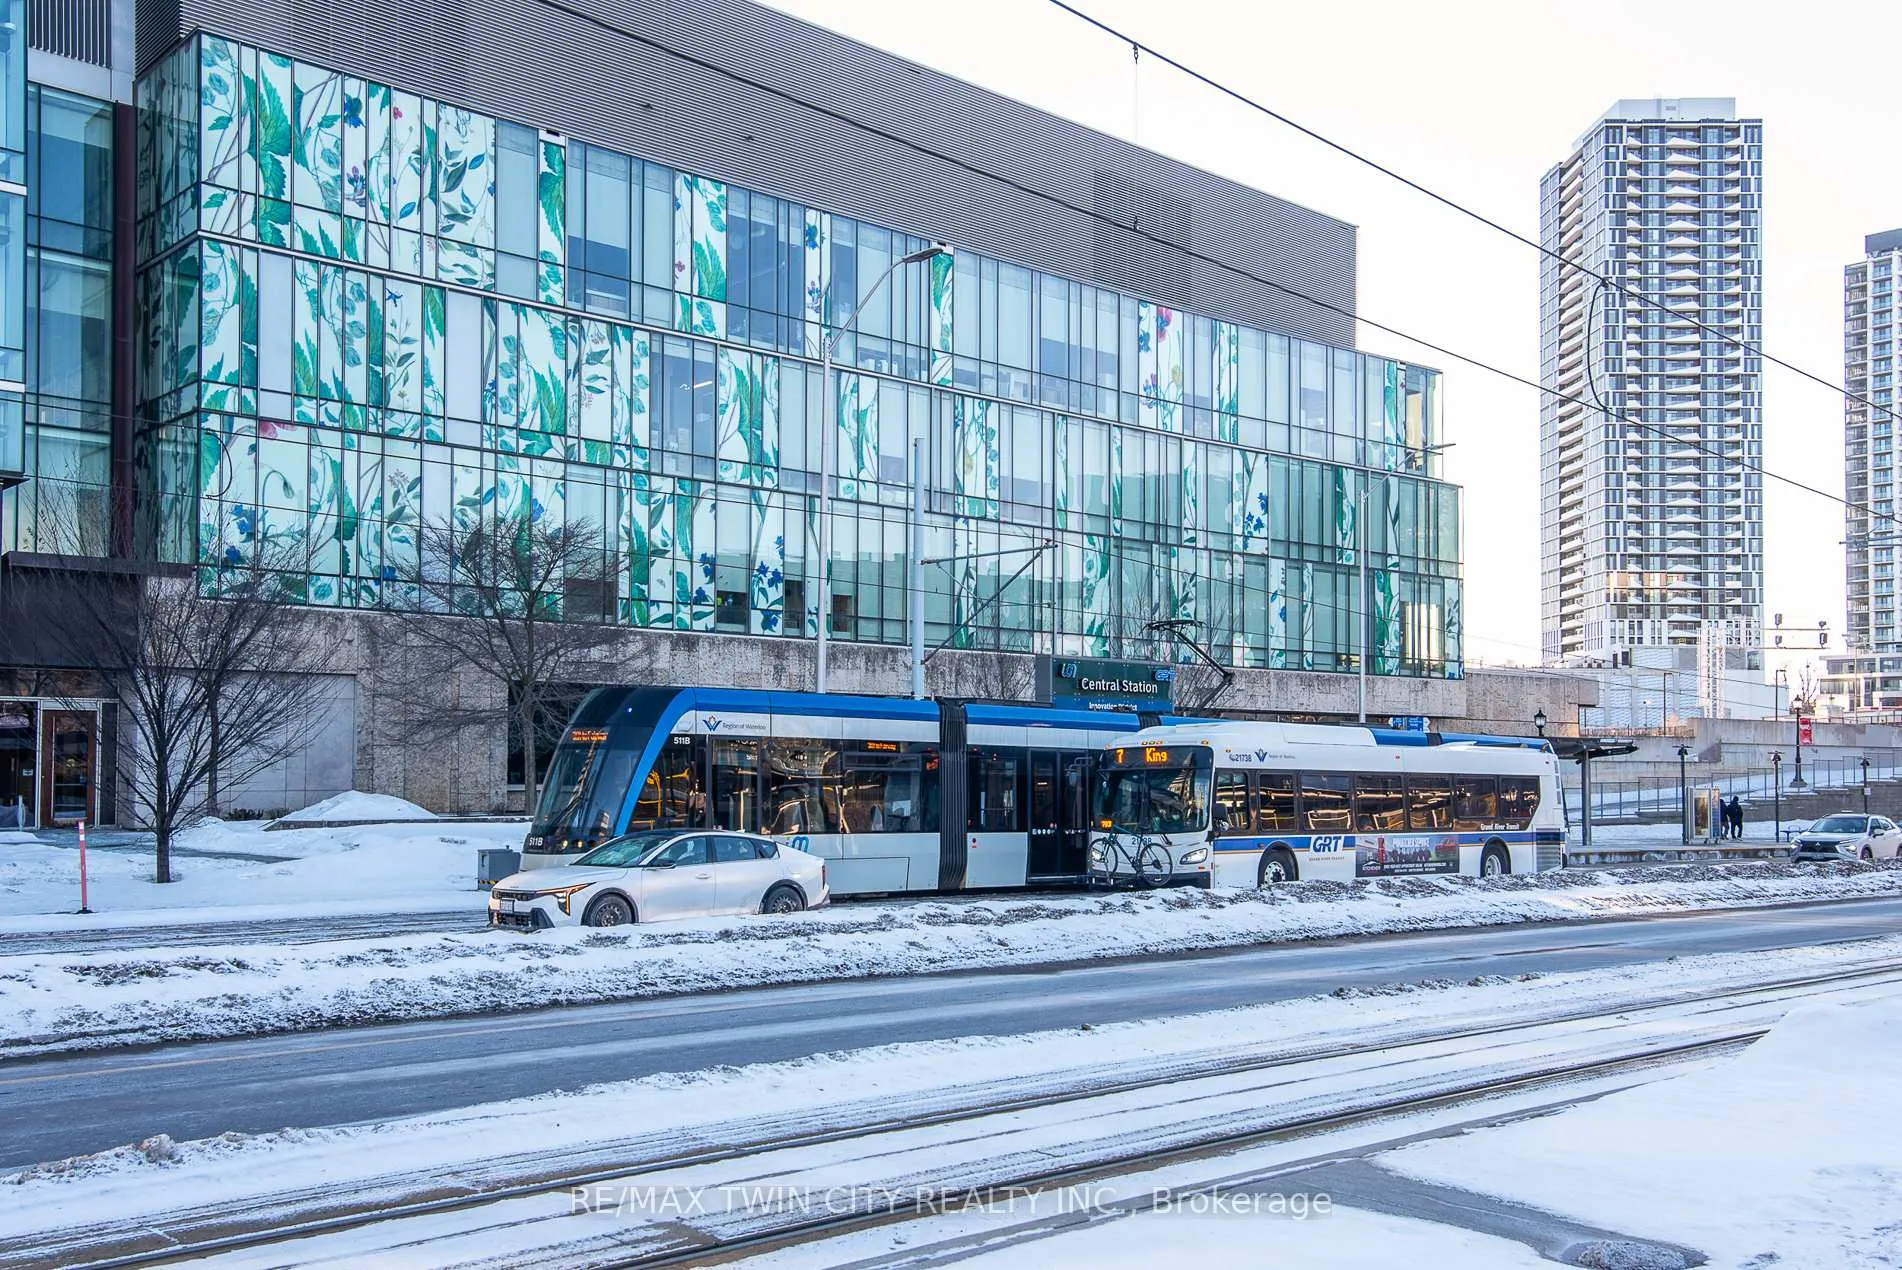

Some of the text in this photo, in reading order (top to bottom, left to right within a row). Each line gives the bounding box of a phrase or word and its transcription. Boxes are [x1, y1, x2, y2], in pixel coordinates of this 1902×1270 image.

[1081, 677, 1158, 694] Central Station
[673, 736, 691, 745] 511B
[1115, 747, 1168, 764] 7 King
[528, 836, 544, 847] 511B
[1131, 837, 1153, 846] 2138
[1312, 835, 1342, 853] GRT
